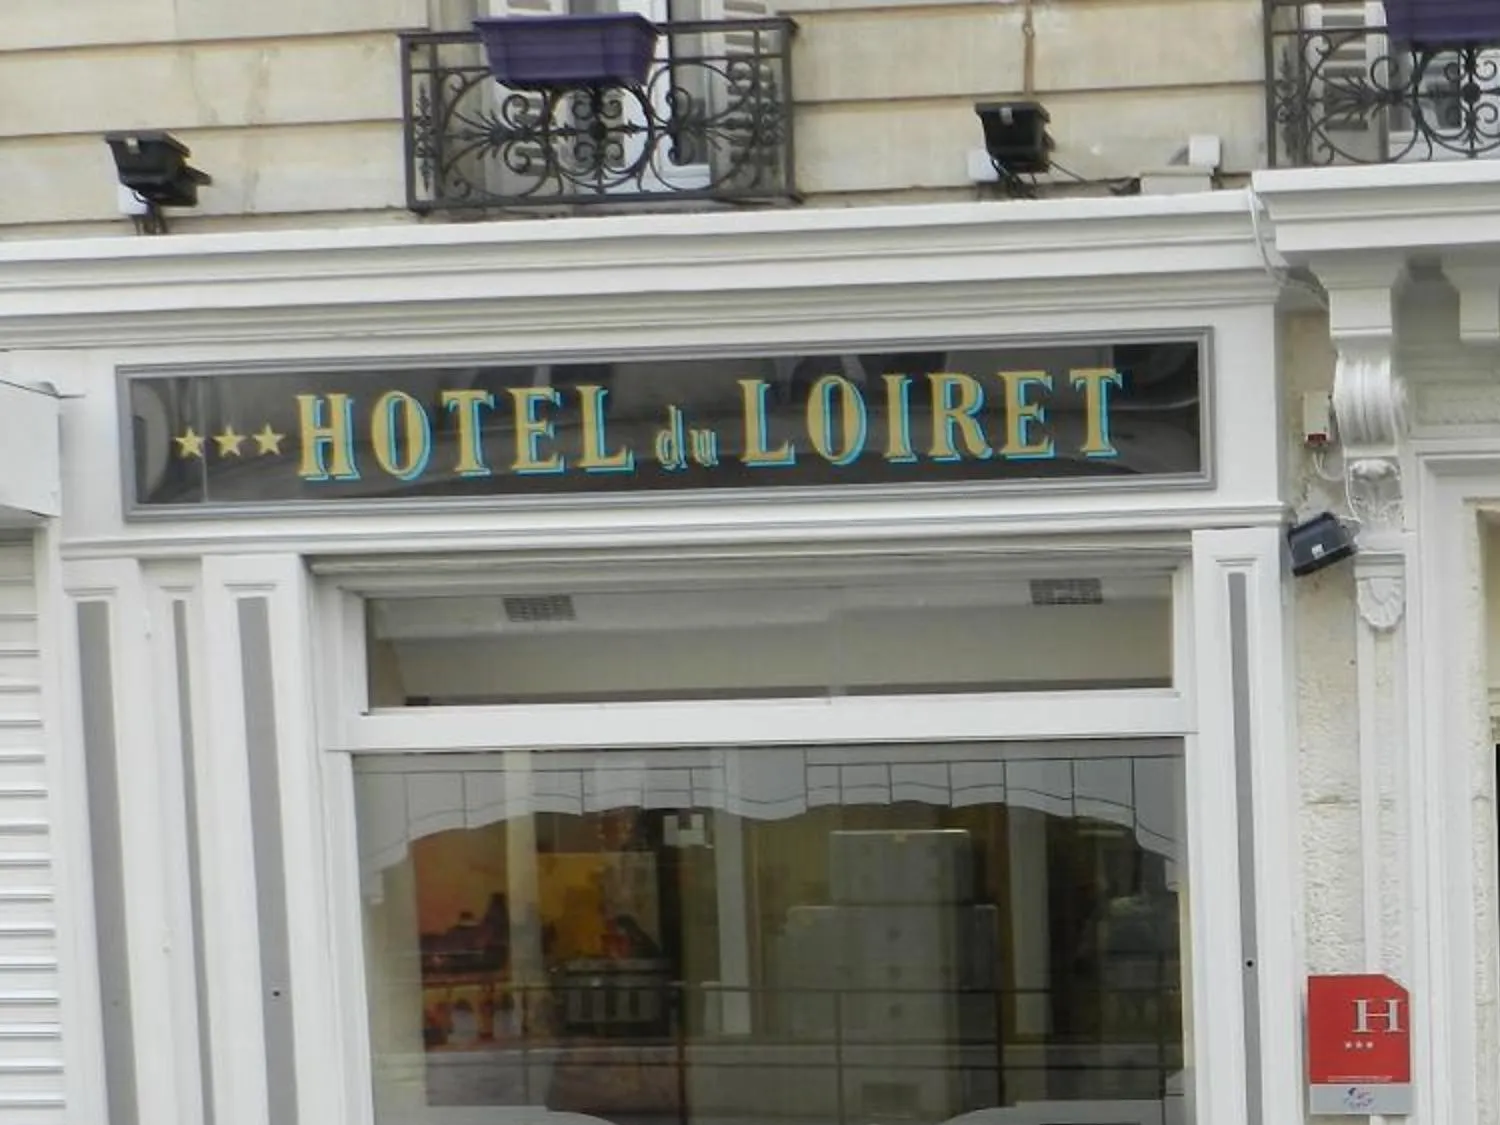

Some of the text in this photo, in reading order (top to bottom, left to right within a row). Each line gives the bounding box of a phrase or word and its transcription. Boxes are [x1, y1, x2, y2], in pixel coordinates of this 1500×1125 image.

[295, 367, 1123, 481] HOTEL du LOIRET
[1351, 999, 1406, 1033] H
